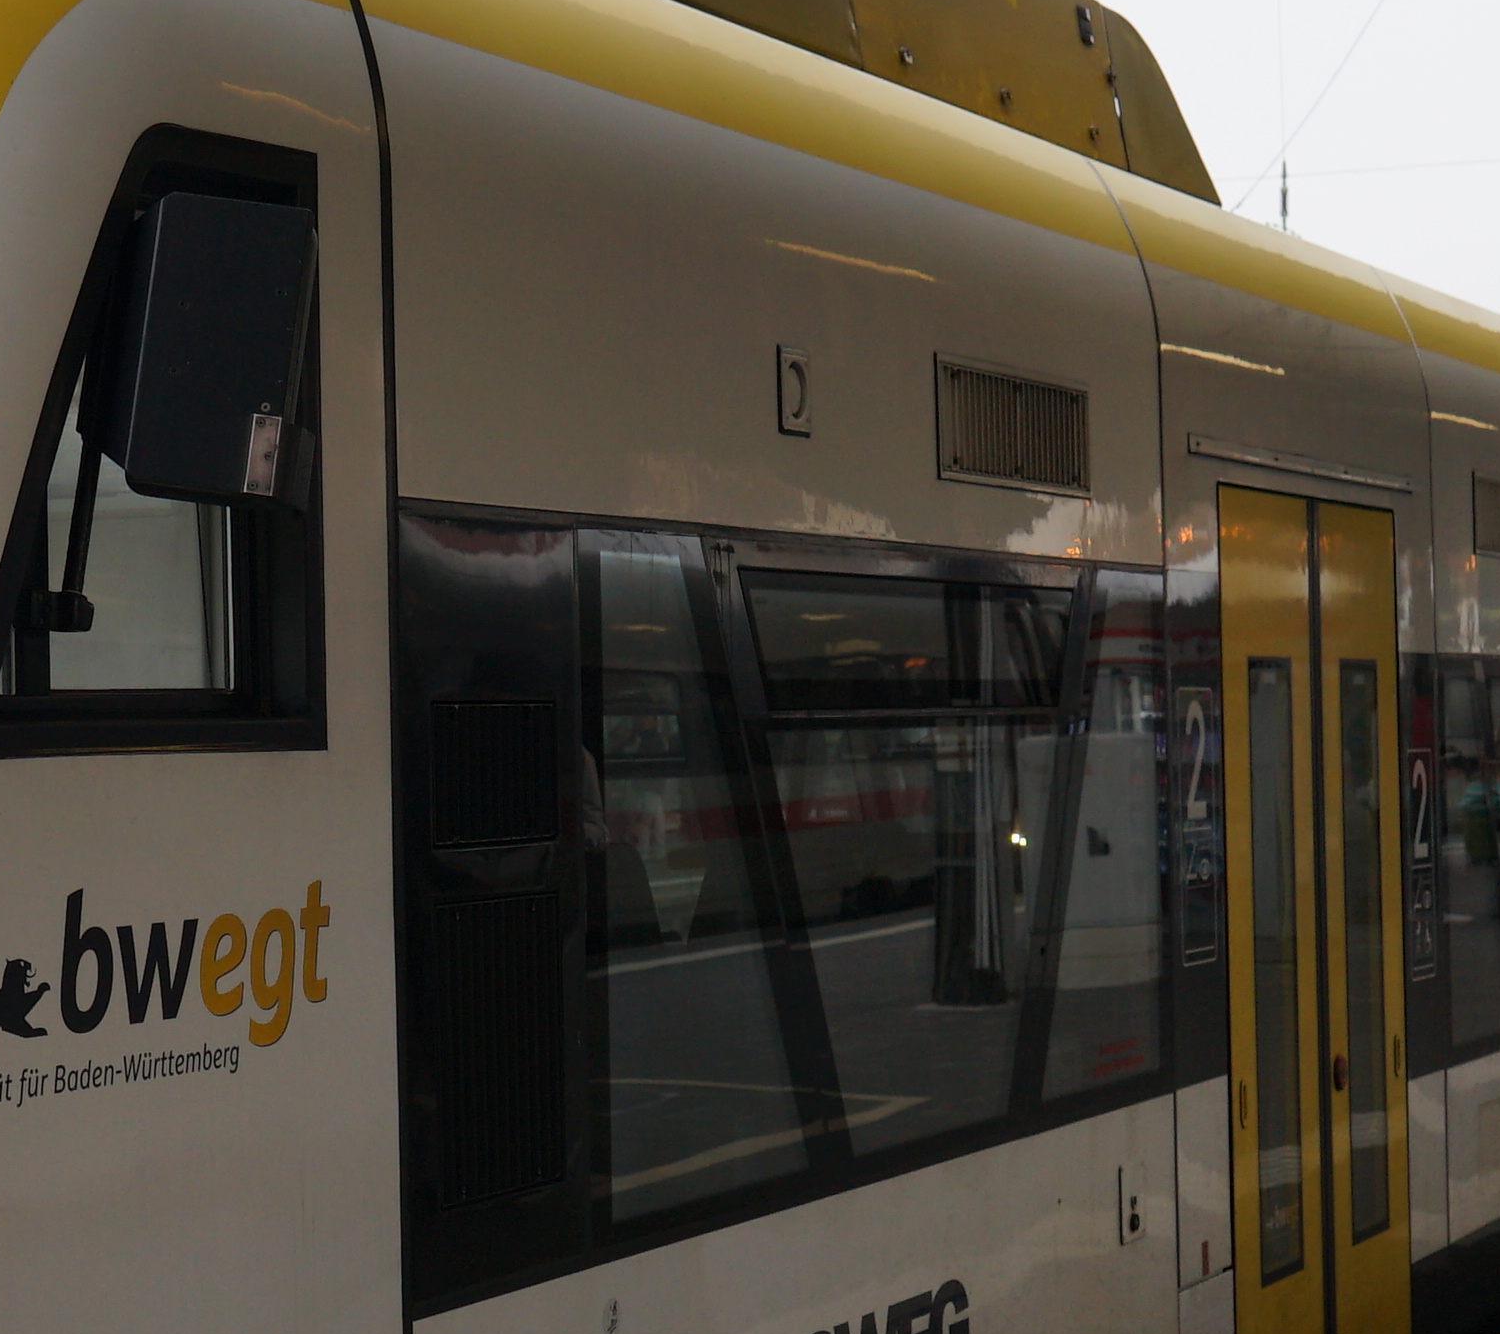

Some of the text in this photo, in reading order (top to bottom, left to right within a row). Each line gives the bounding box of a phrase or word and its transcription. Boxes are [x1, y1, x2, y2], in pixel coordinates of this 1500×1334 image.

[1185, 698, 1208, 821] 2
[1412, 758, 1429, 859] 2
[59, 879, 331, 1046] bwegt
[16, 1067, 49, 1108] für
[53, 1043, 241, 1095] Baden-Württemberg
